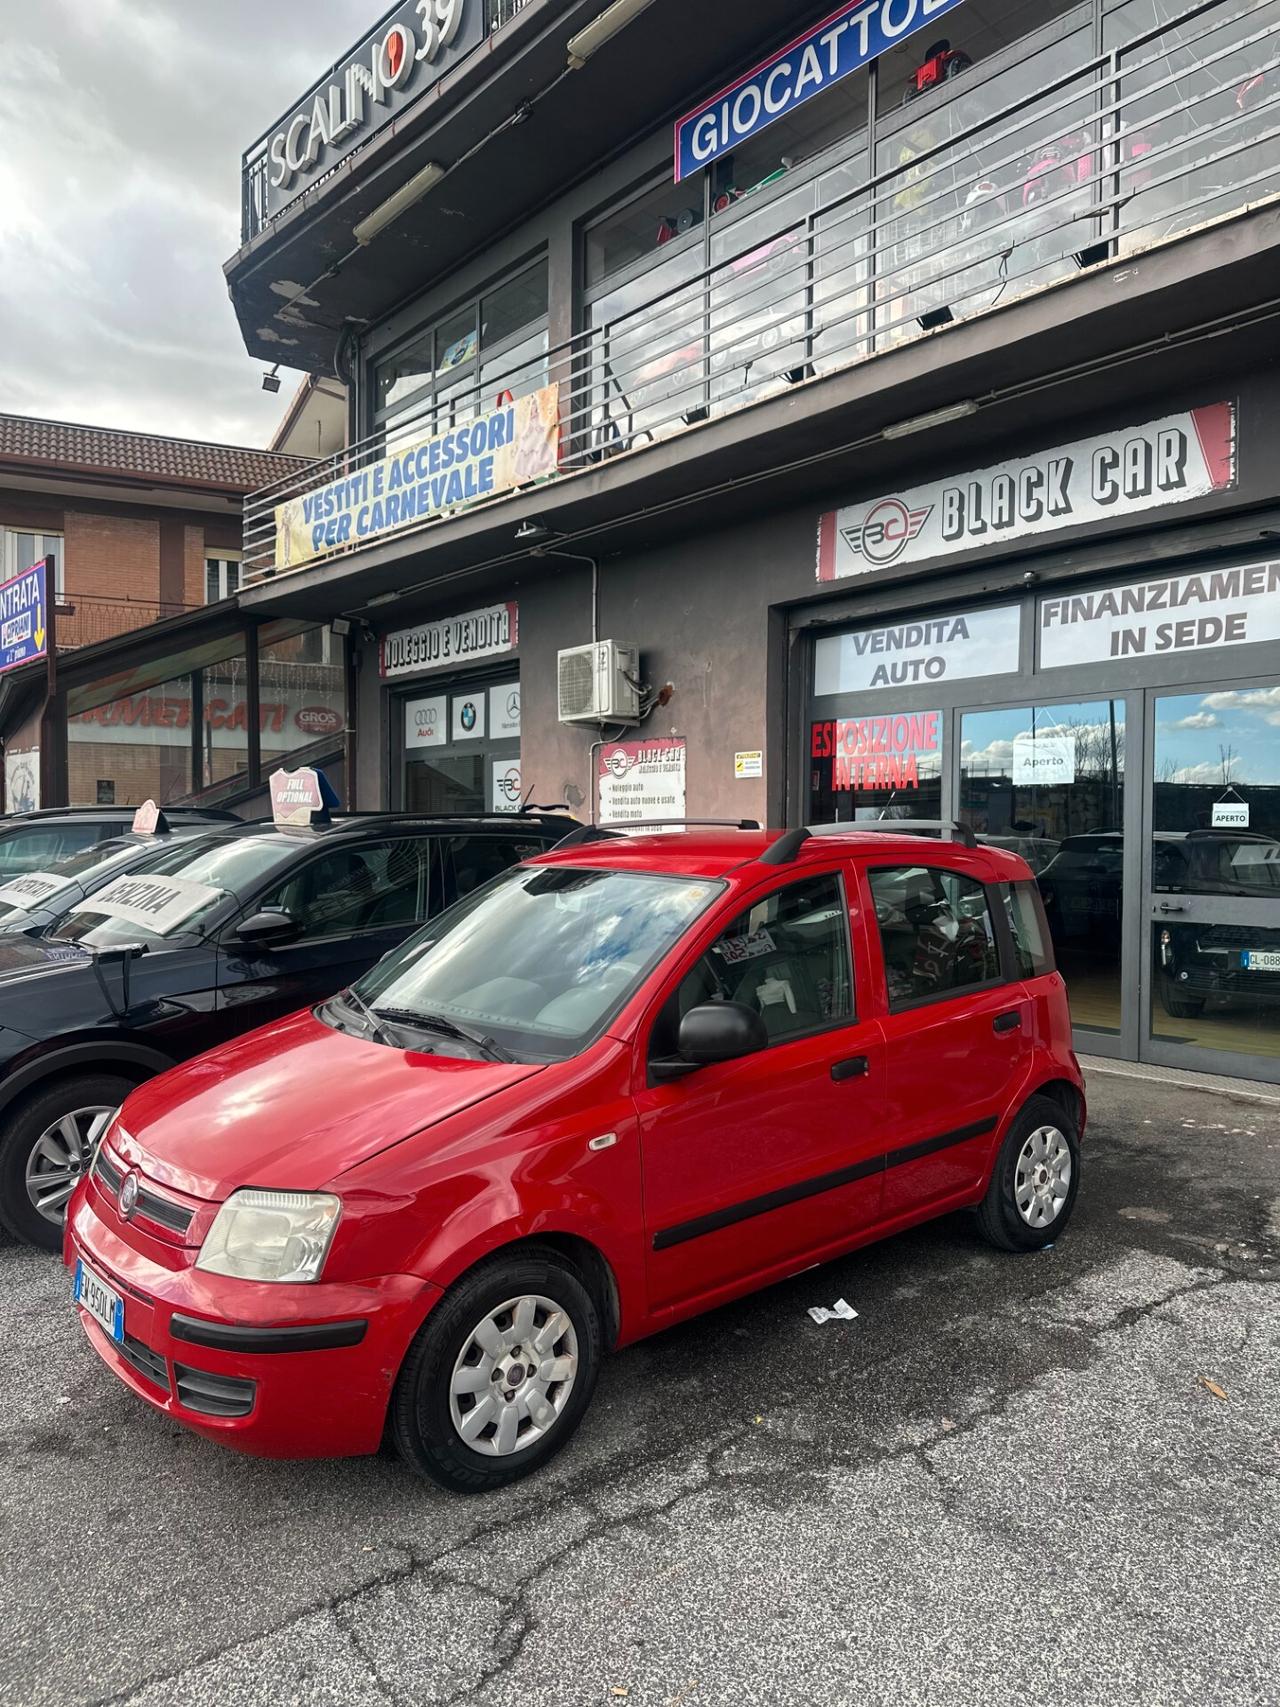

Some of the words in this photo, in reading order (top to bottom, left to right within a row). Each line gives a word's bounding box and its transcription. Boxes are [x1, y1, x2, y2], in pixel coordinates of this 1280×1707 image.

[270, 23, 416, 190] SCALINO
[414, 0, 464, 65] 39
[302, 470, 368, 525] VESTITI
[373, 467, 384, 498] E
[388, 408, 515, 490] ACCESSORI
[942, 456, 1074, 541] BLACK
[1091, 428, 1187, 505] CAR
[312, 513, 351, 552] PER
[356, 456, 494, 536] CARNEVALE
[385, 629, 440, 670] NOLEGGIO
[443, 625, 450, 657] E
[454, 609, 511, 654] VENDITA
[853, 616, 970, 657] VENDITA
[1110, 626, 1146, 657] IN
[1155, 612, 1247, 651] SEDE
[870, 655, 946, 687] AUTO
[299, 711, 336, 723] GROS
[417, 727, 434, 737] Audi
[811, 712, 939, 758] ESPOSIZIONE
[831, 753, 919, 792] INTERNA
[1023, 757, 1064, 768] Aperto
[276, 791, 313, 804] OPTIONAL
[286, 778, 305, 790] FULL
